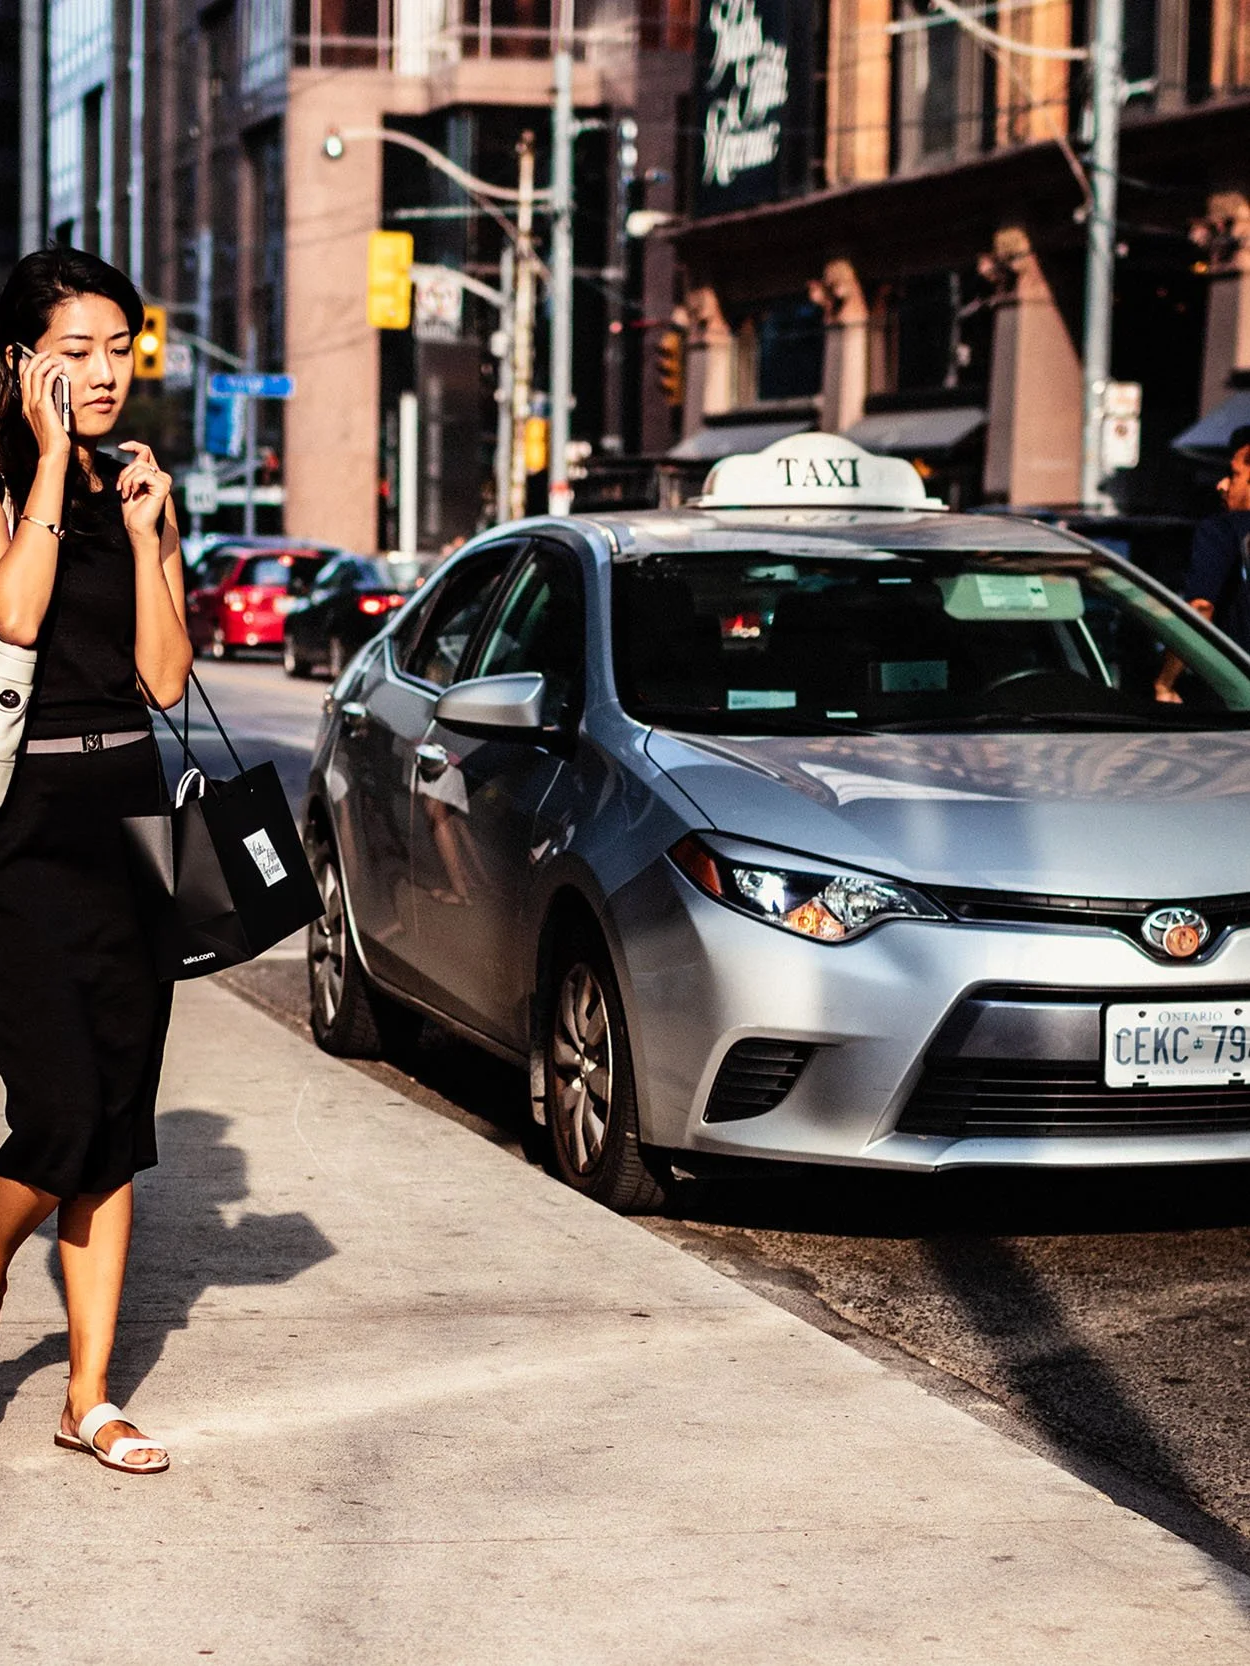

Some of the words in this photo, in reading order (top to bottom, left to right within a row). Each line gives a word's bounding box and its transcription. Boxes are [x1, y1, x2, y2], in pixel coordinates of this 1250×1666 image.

[777, 457, 860, 487] TAXI
[182, 951, 216, 965] saks.com
[1158, 1011, 1223, 1024] ONTARIO
[1113, 1026, 1189, 1065] CEKC
[1210, 1024, 1250, 1064] 79
